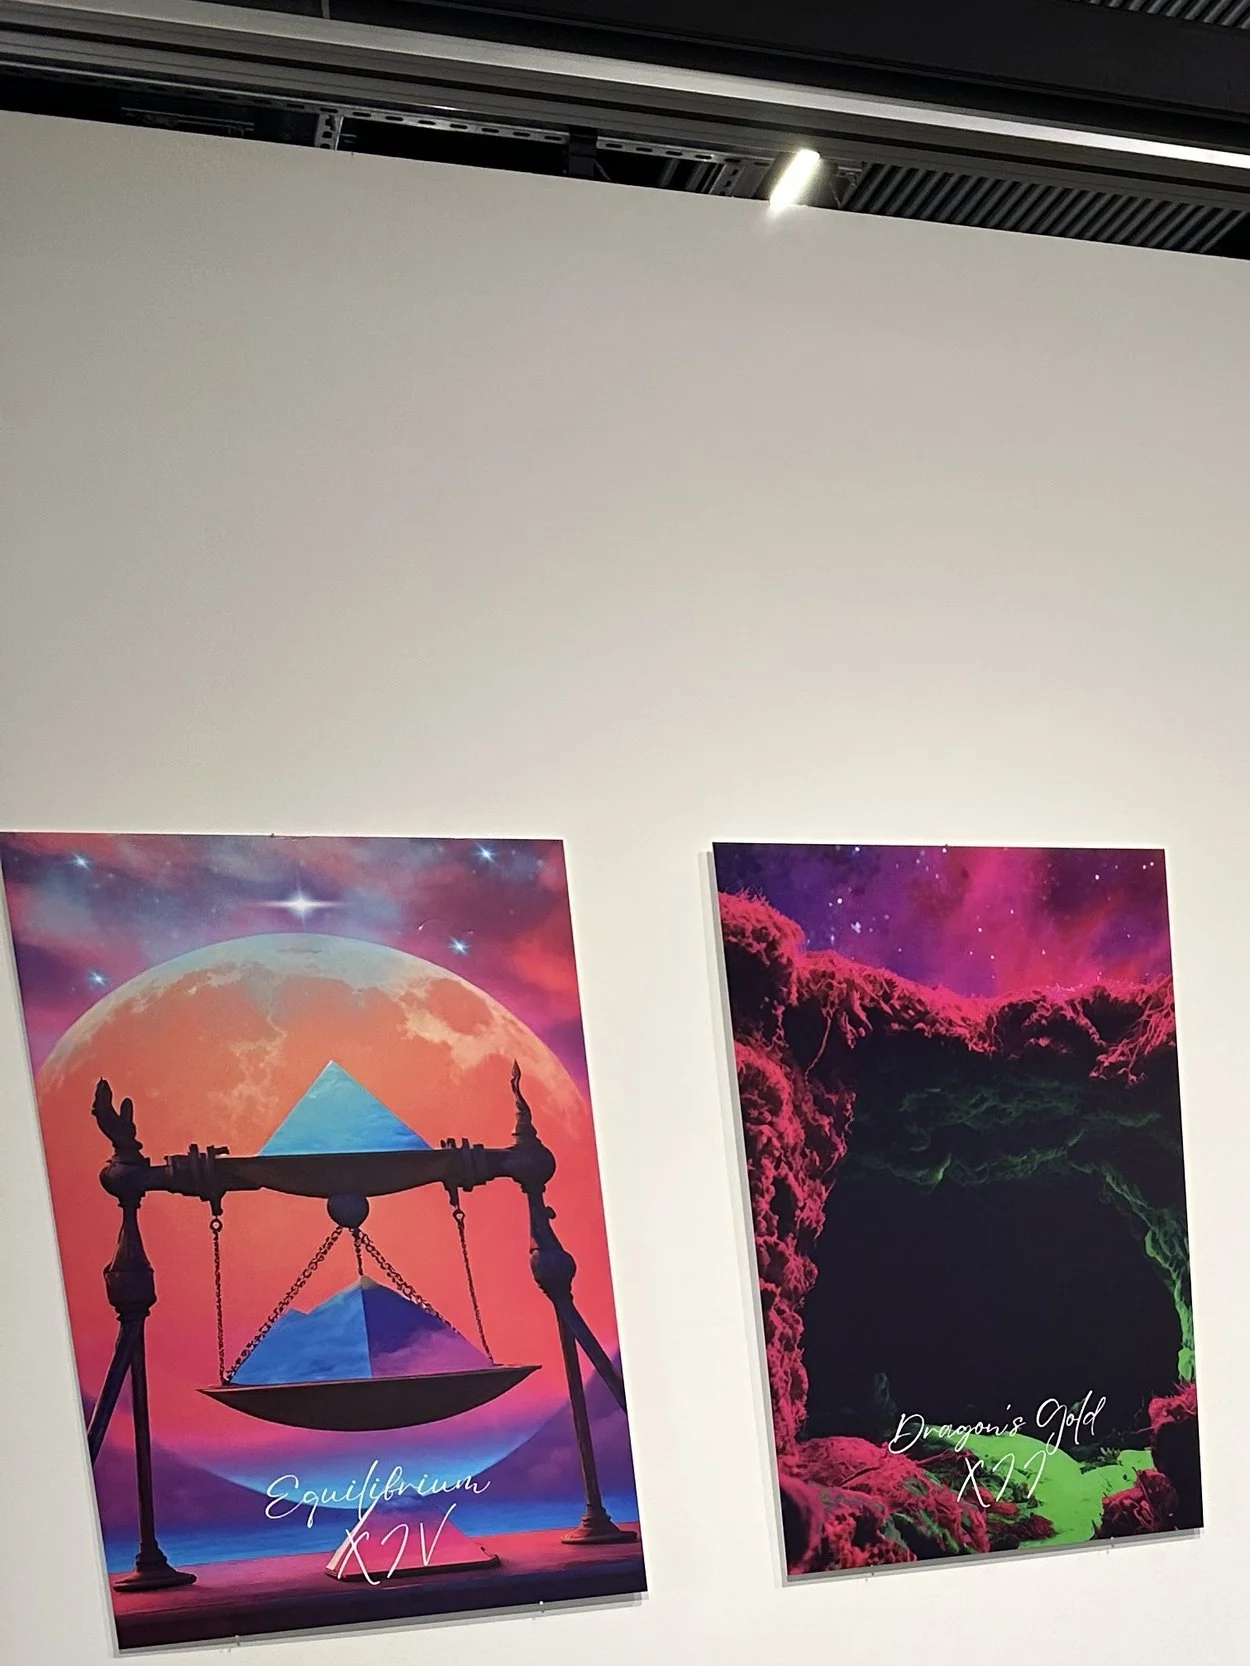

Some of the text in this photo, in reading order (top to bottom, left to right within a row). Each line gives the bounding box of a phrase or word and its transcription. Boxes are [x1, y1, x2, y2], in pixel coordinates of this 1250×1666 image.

[888, 1390, 1106, 1455] Dragon's Gold
[265, 1460, 491, 1528] Equilibrium
